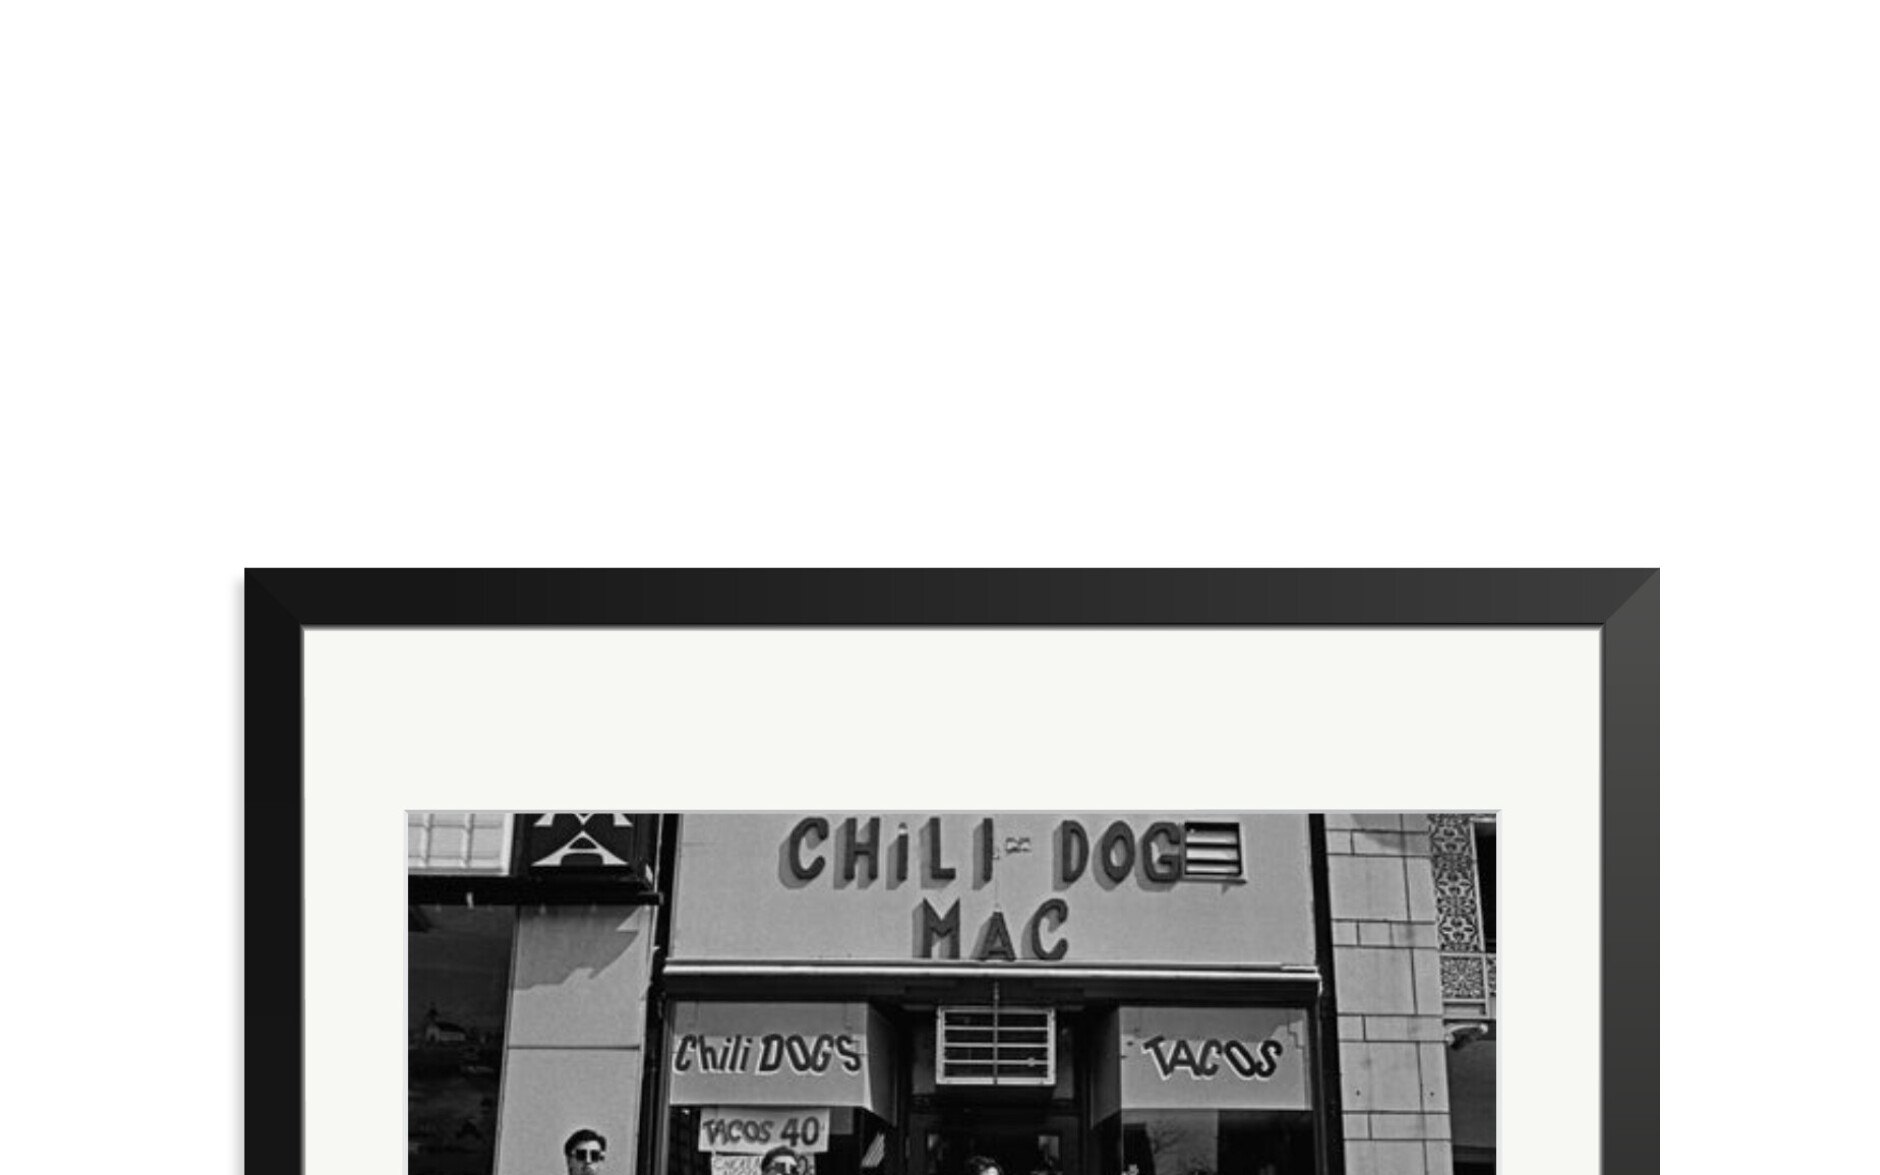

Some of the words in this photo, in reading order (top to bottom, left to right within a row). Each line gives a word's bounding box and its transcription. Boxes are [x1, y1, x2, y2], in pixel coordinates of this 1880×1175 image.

[1054, 820, 1182, 890] DOG
[912, 898, 1069, 962] MAC
[673, 1034, 753, 1074] Chili
[757, 1033, 862, 1076] DOGS
[1142, 1035, 1283, 1080] TACOS
[702, 1118, 774, 1146] TACOS
